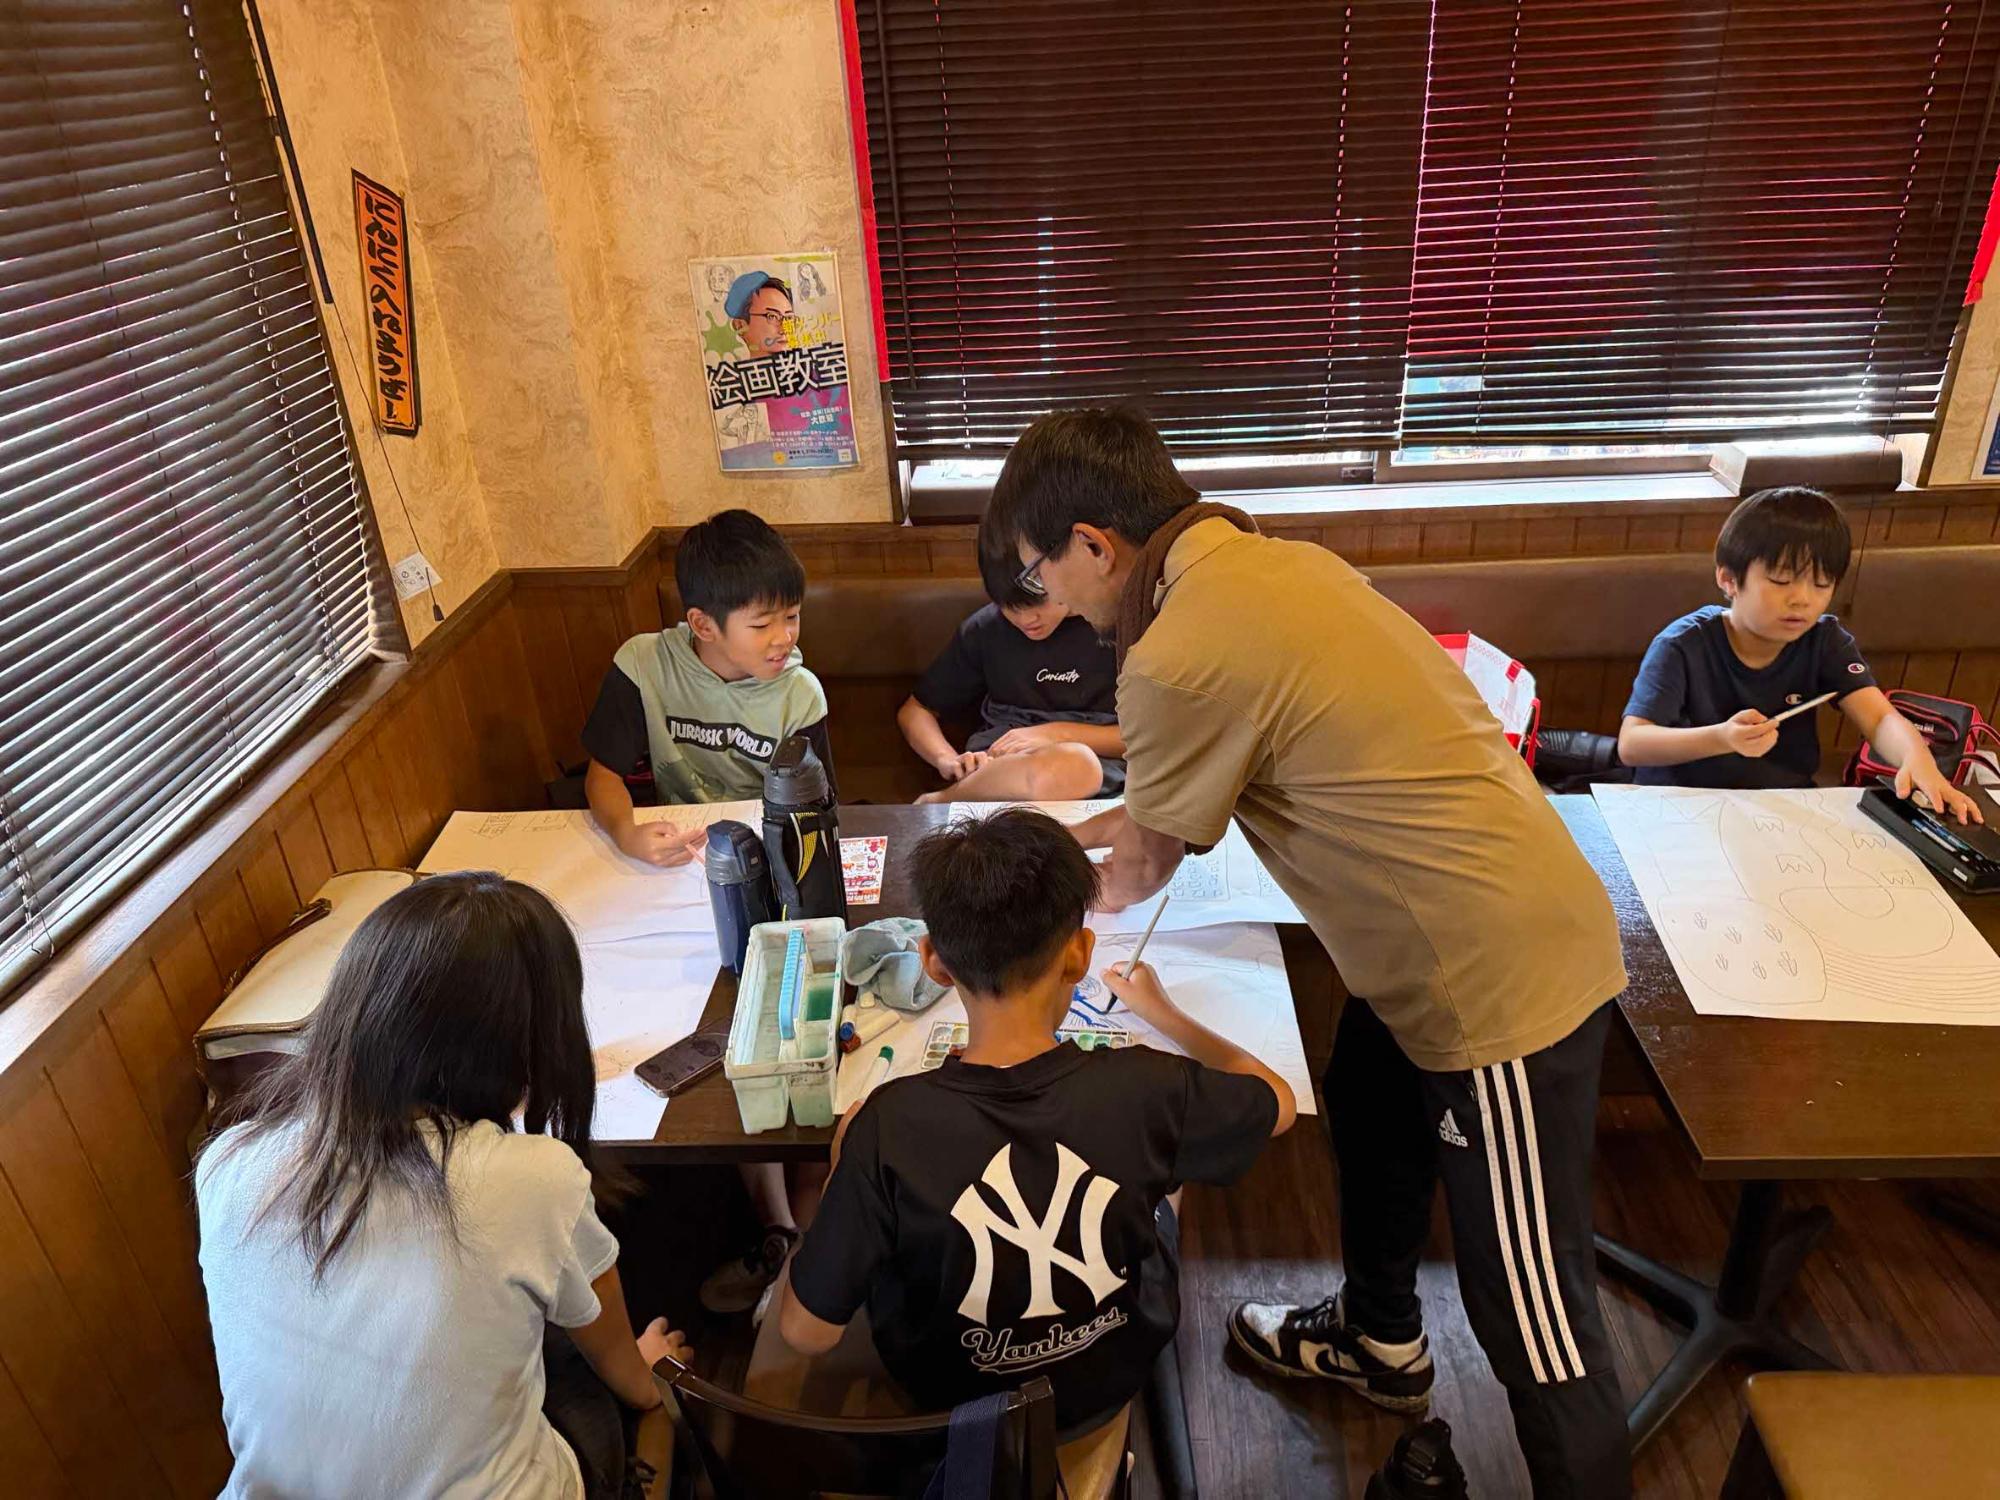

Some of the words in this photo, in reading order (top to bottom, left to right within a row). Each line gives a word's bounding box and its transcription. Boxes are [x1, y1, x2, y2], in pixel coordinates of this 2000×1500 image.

[708, 346, 849, 406] 絵画教室
[671, 720, 724, 746] JURASSIC
[726, 727, 773, 758] WORLD
[960, 1306, 1129, 1374] Yankees
